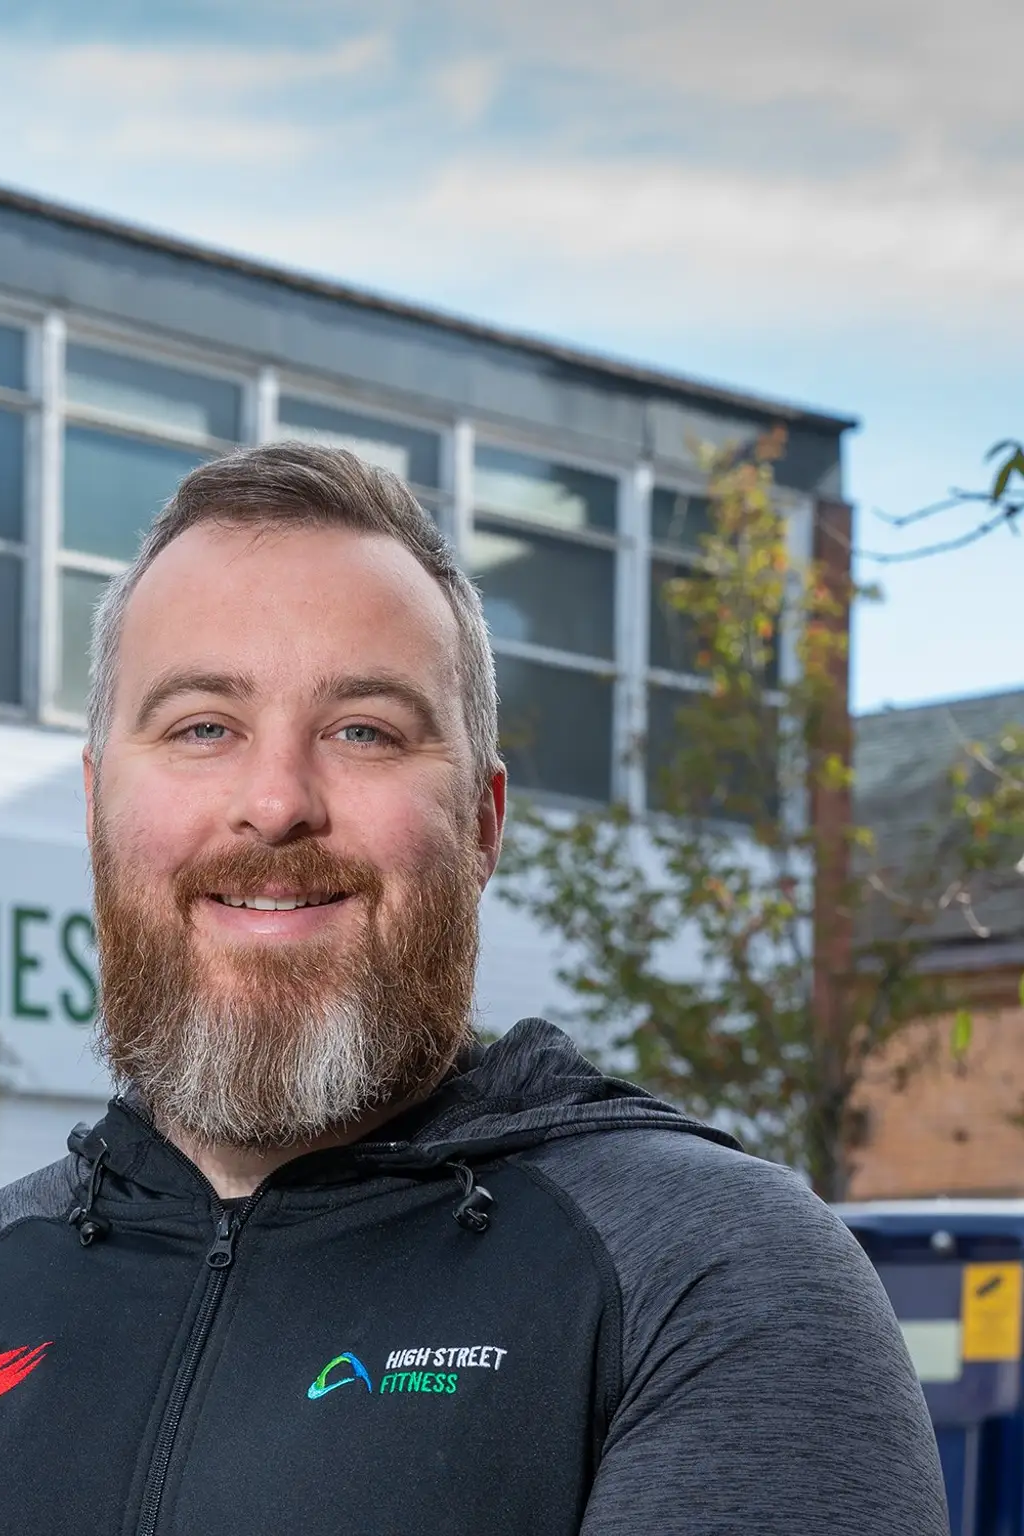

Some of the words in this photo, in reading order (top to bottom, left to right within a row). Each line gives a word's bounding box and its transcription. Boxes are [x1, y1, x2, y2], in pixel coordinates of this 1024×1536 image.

[385, 1347, 432, 1370] HIGH
[432, 1345, 508, 1370] STREET
[379, 1371, 458, 1394] FITNESS
